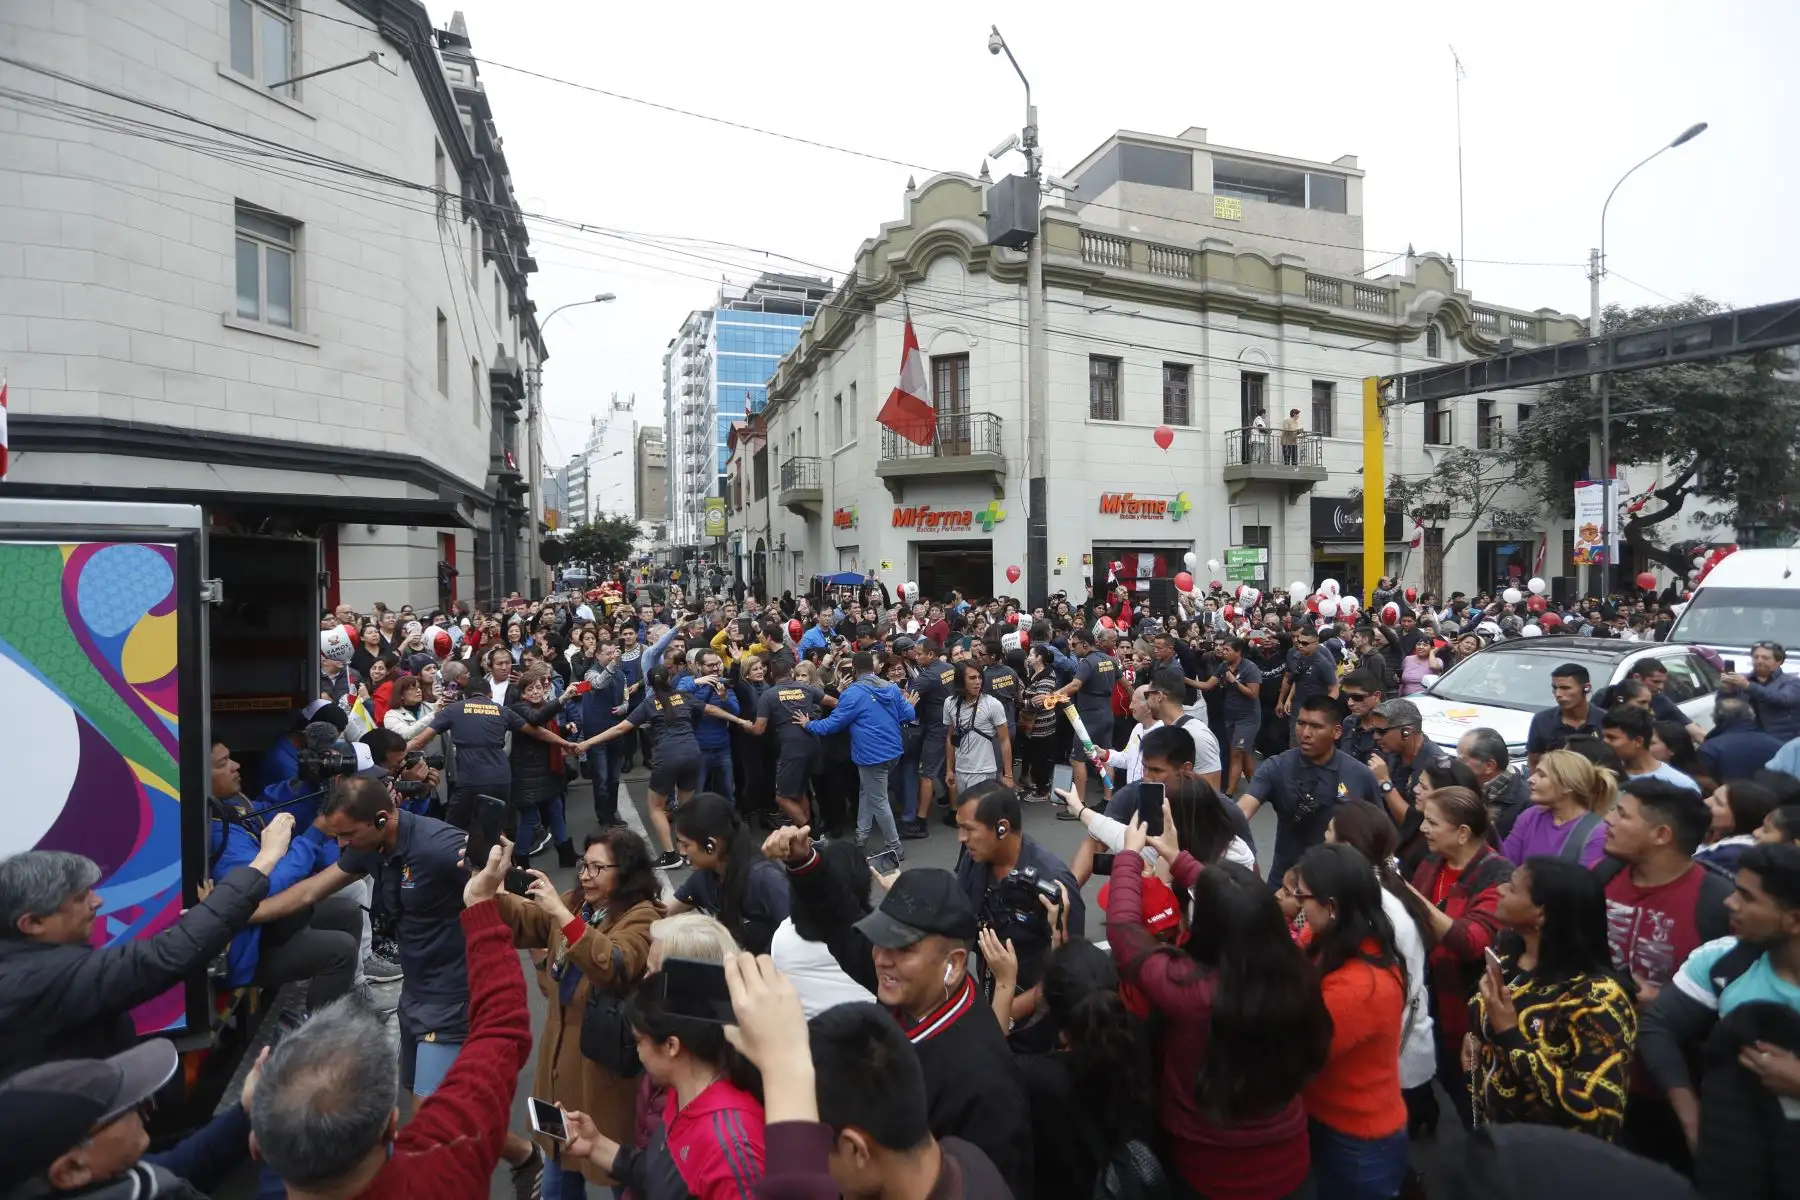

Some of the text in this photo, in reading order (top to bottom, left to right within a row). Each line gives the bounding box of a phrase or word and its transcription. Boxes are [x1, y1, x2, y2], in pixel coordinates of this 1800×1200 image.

[1099, 492, 1166, 514] Mifarma
[892, 505, 973, 528] Mifarma
[464, 703, 499, 711] MINISTERIO
